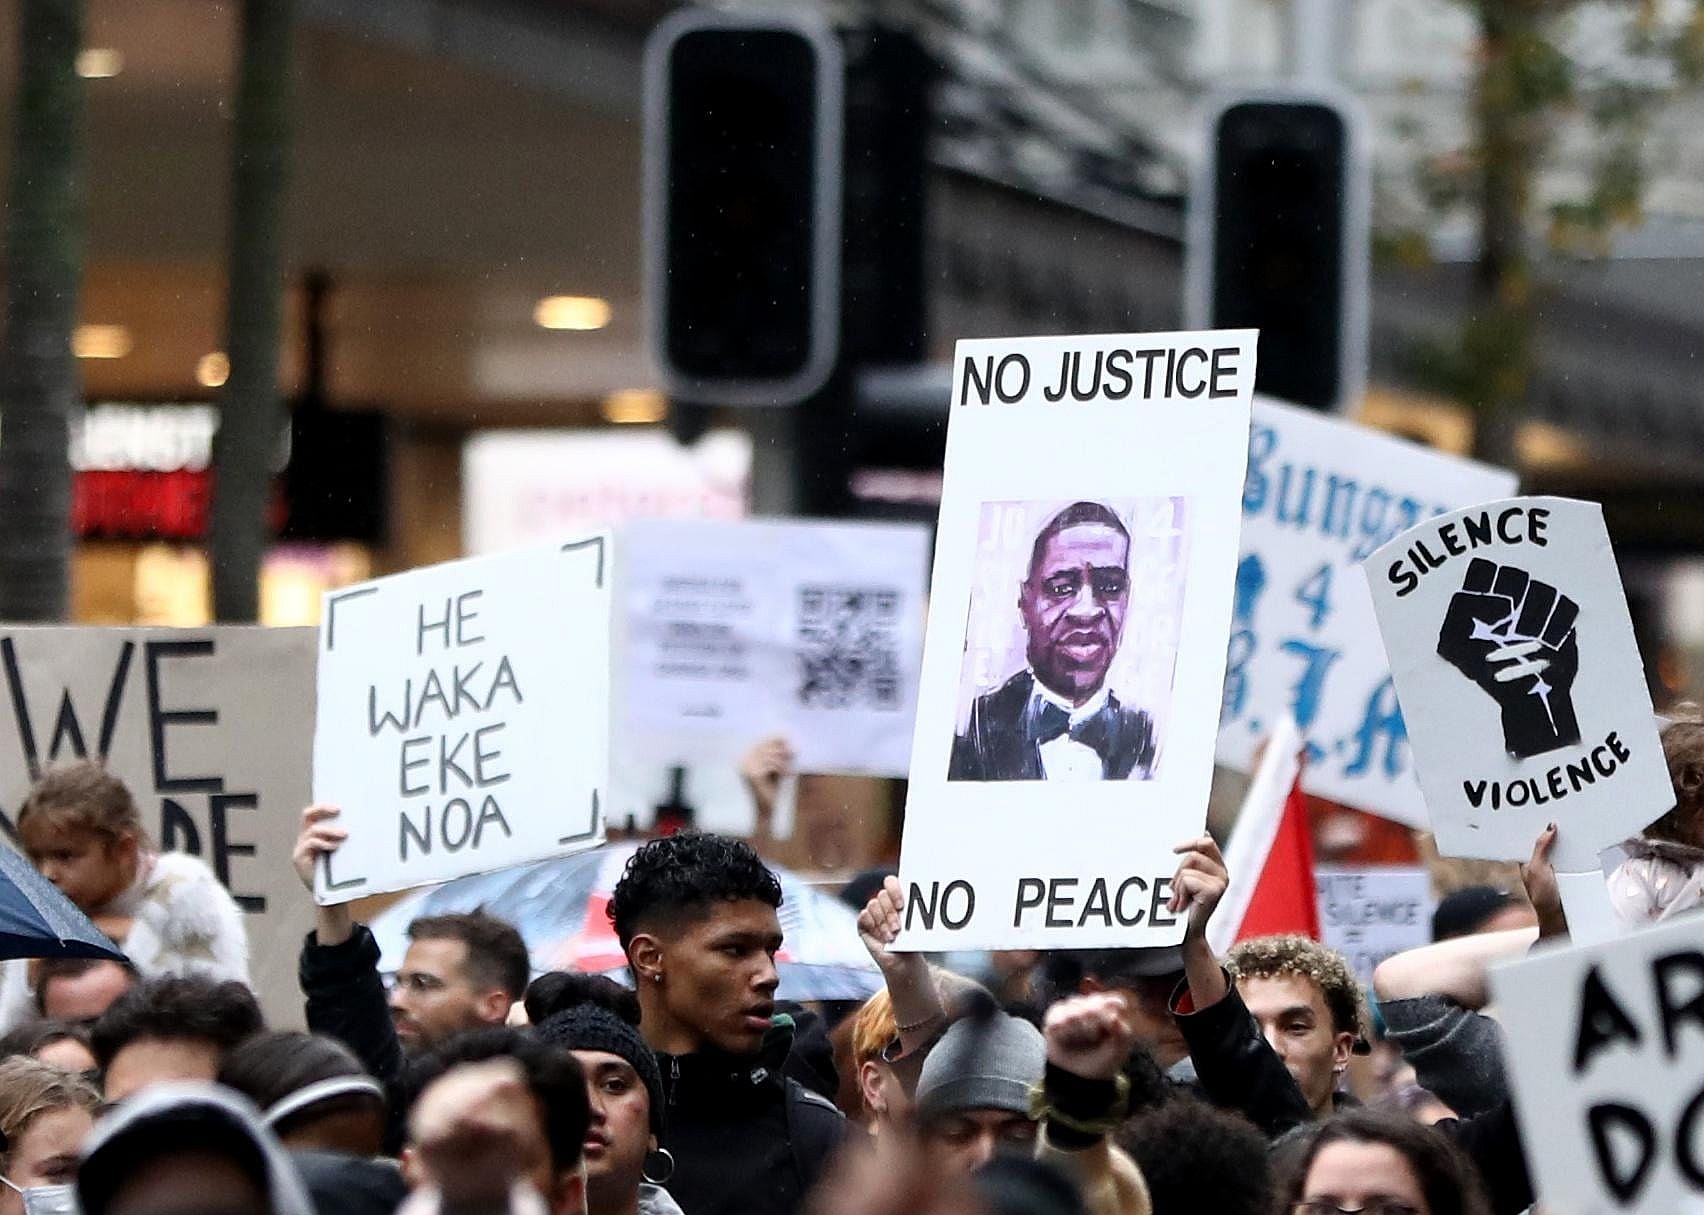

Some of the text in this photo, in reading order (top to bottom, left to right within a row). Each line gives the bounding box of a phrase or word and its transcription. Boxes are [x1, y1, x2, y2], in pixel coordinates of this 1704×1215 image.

[960, 347, 1240, 406] NO JUSTICE
[1387, 507, 1550, 598] SILENCE
[417, 590, 486, 655] HE
[0, 636, 223, 794] WE
[369, 656, 523, 736] WAKA
[400, 723, 511, 798] EKE
[1463, 731, 1631, 811] VIOLENCE
[400, 798, 512, 862] NOA
[905, 875, 1179, 931] NO PEACE
